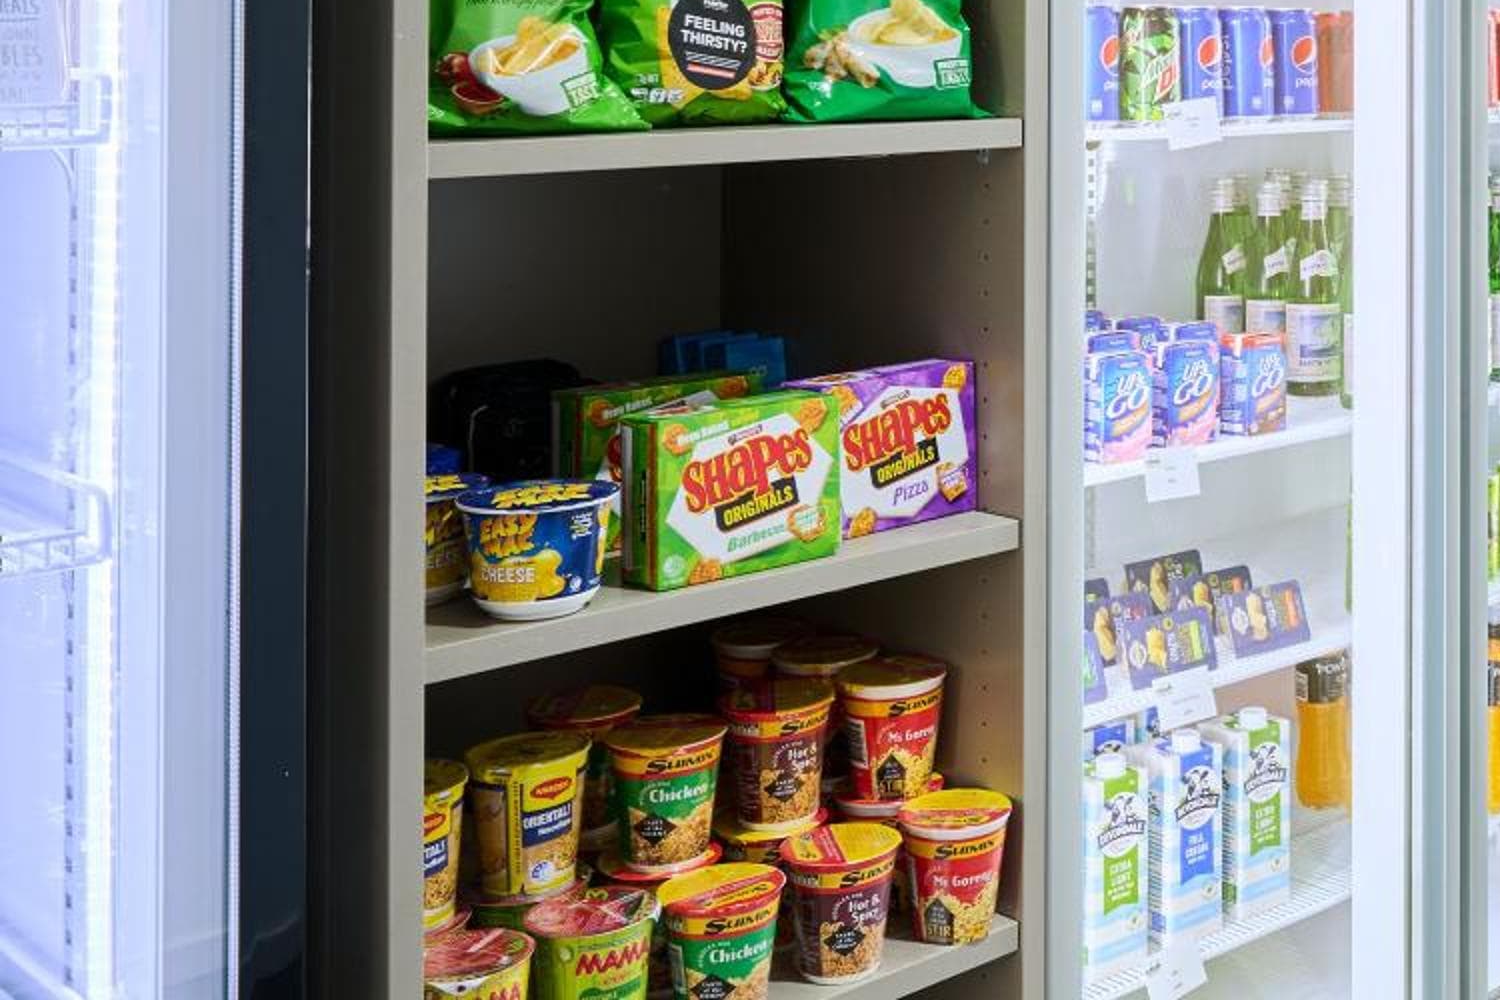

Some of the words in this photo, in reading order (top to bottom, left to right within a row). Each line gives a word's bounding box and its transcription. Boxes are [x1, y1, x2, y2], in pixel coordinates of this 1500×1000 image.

[683, 14, 745, 38] FEELING
[680, 29, 748, 54] THIRSTY?
[877, 446, 935, 483] ORIGINALS
[892, 480, 930, 507] Pizza
[723, 485, 795, 528] ORIGINALS
[481, 567, 535, 584] CHEESE
[650, 782, 708, 804] Chicken
[849, 899, 869, 913] Hot
[709, 940, 769, 964] Chicken
